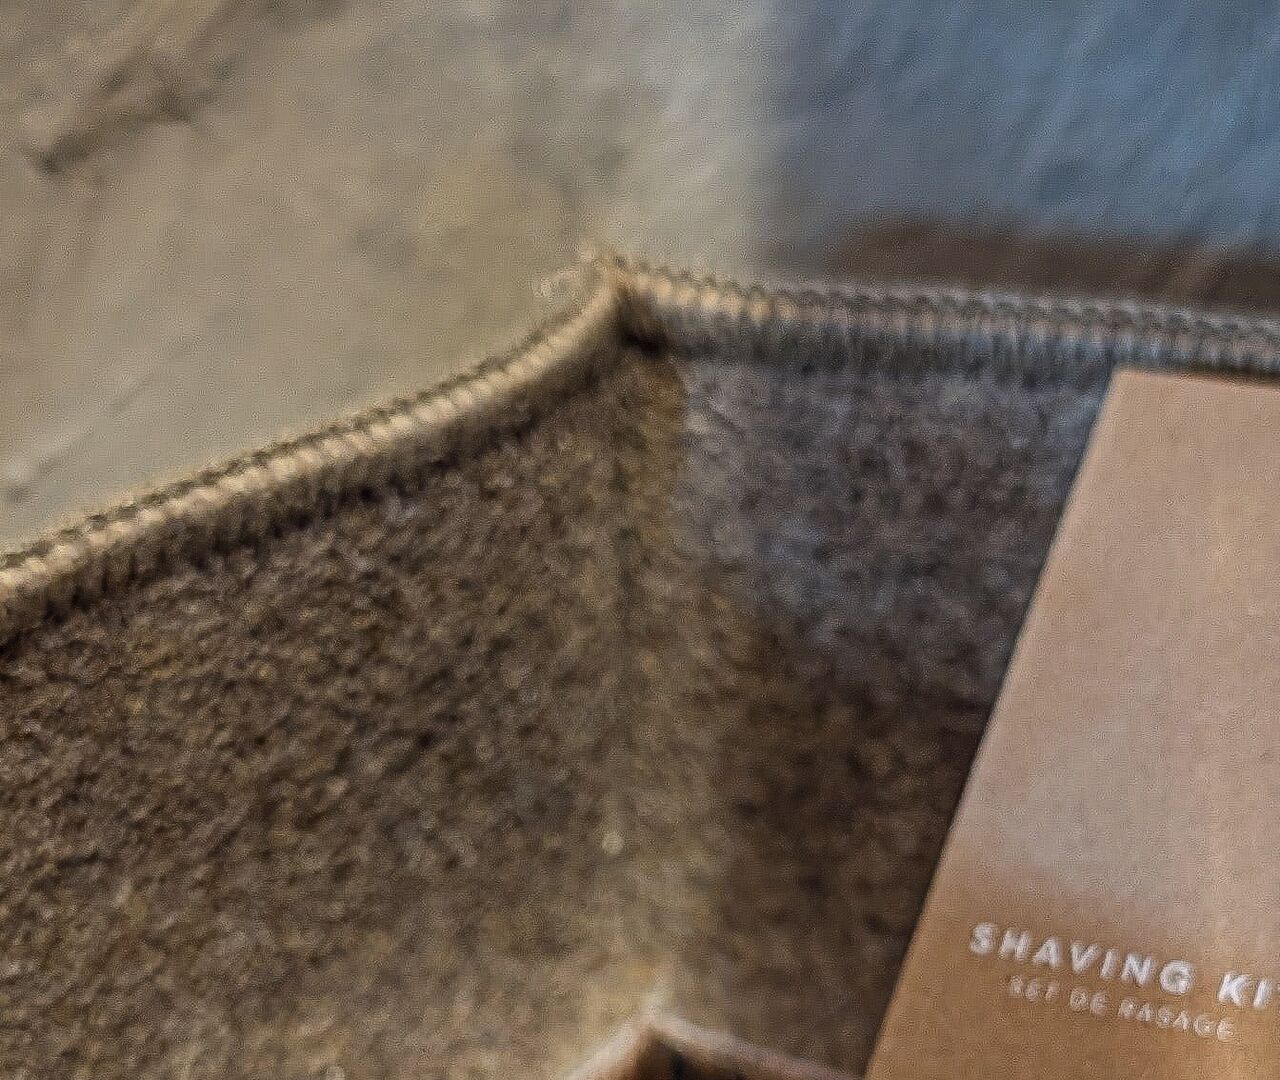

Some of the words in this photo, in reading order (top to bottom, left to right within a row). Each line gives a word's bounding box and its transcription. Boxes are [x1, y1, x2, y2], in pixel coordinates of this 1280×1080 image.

[969, 922, 1196, 995] SHAVING
[1008, 975, 1060, 1002] SET
[1070, 986, 1109, 1016] DE
[1119, 997, 1235, 1041] RASAGE
